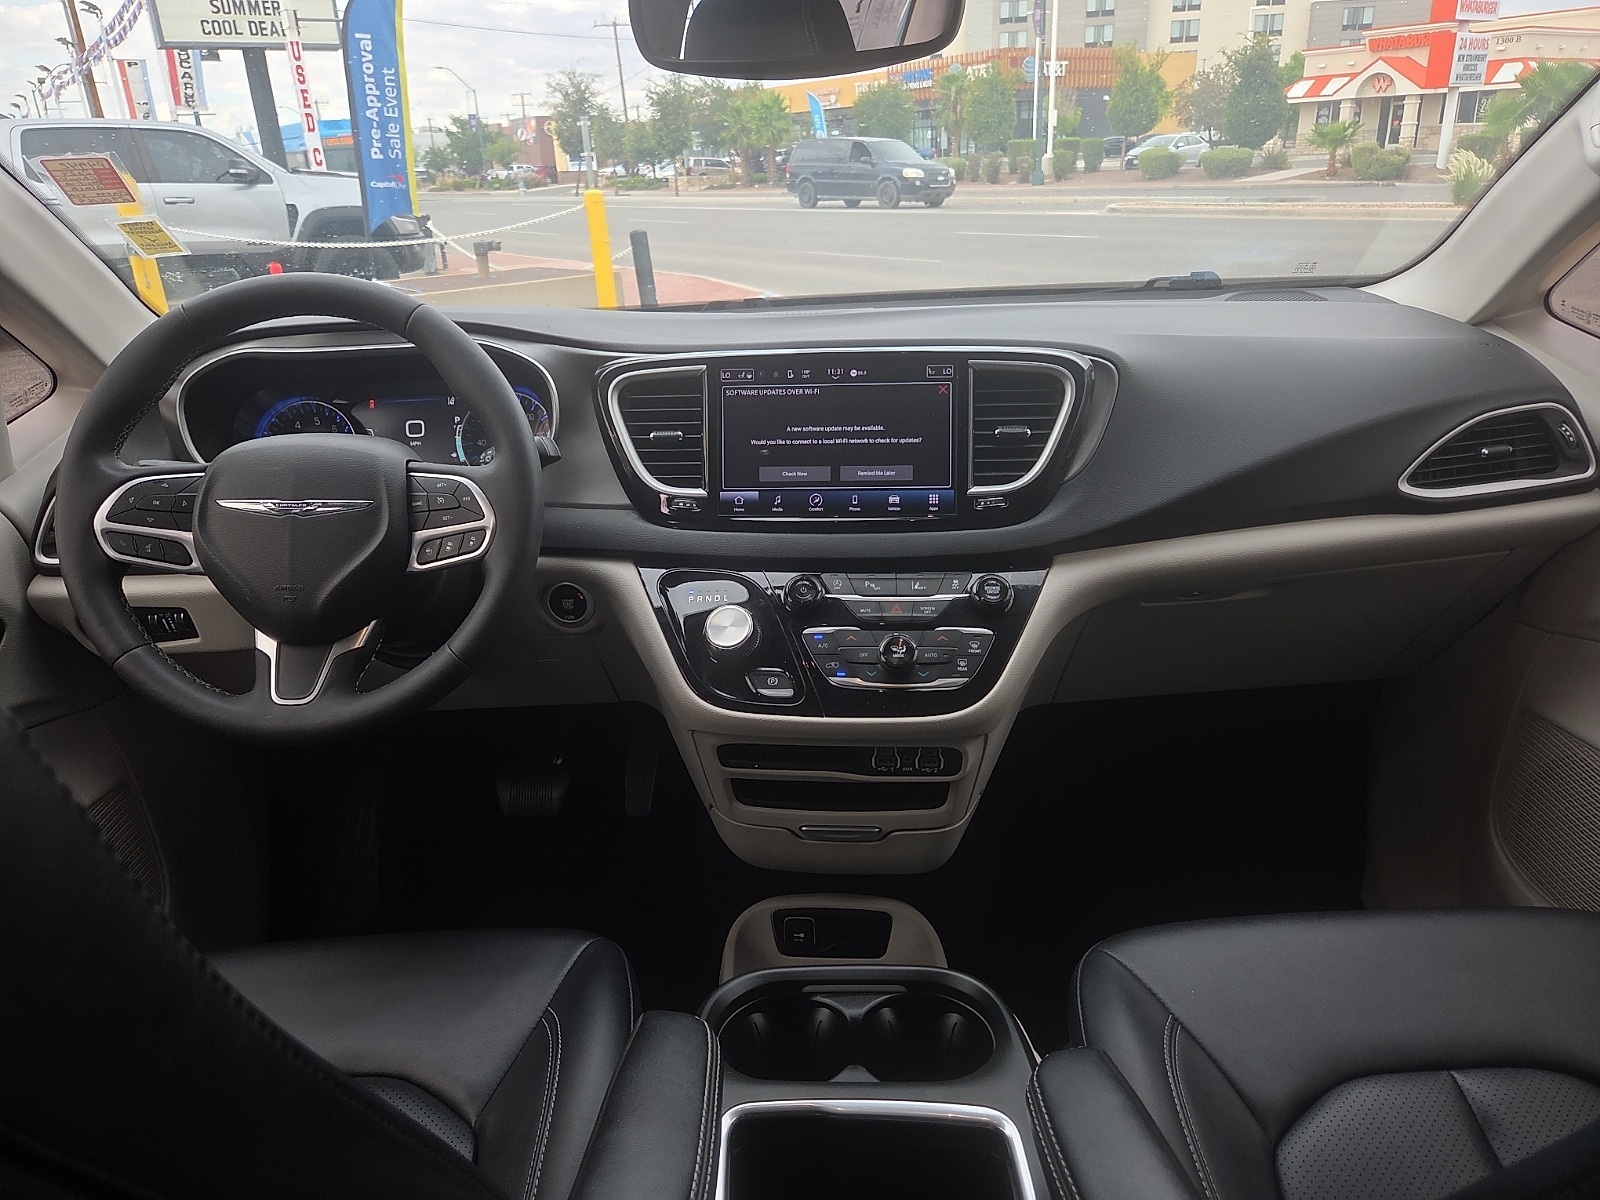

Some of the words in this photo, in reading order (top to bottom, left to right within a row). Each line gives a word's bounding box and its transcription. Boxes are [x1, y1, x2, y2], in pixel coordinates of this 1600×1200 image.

[210, 0, 281, 16] SUMMER
[200, 20, 243, 36] COOL
[1459, 37, 1468, 50] 24
[1468, 37, 1490, 51] HOURS
[355, 33, 384, 160] Pre-Approval
[382, 67, 399, 118] Event
[385, 121, 402, 160] Sale
[294, 420, 302, 430] 4
[313, 416, 321, 426] 5
[331, 424, 338, 433] 6
